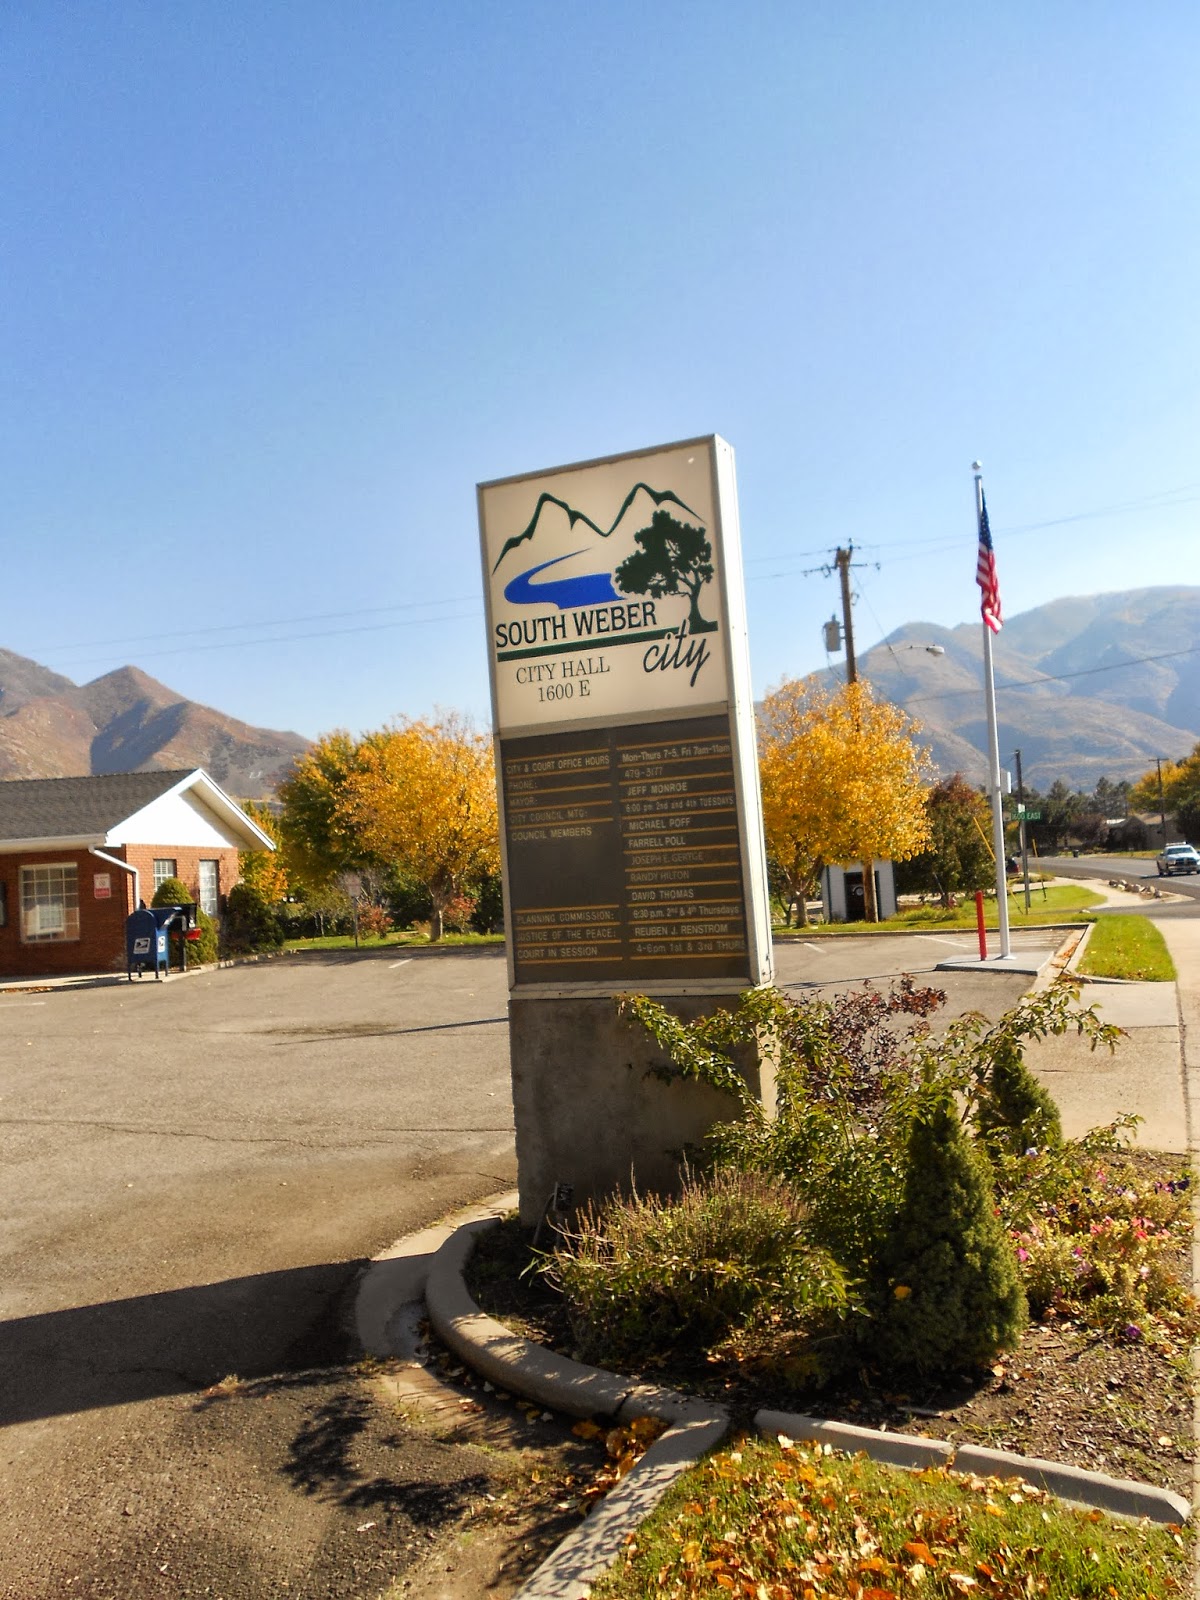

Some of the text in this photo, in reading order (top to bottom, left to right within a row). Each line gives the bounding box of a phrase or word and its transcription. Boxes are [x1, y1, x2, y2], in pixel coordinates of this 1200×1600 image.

[496, 601, 657, 648] SOUTH WEBER
[643, 619, 710, 687] city
[516, 656, 610, 684] CITY HALL
[538, 680, 591, 702] 1600 E
[622, 751, 661, 763] Mon-Thurs
[681, 747, 691, 756] Fri
[506, 764, 520, 774] CITY
[532, 761, 555, 772] COURT
[558, 758, 582, 769] OFFICE
[585, 755, 610, 766] HOURS
[627, 782, 688, 796] JEFF MONROE
[656, 801, 668, 810] 2nd
[686, 798, 697, 807] 4th
[700, 796, 735, 807] TUESDAYS
[530, 811, 564, 822] COUNCIL
[567, 808, 588, 818] MTG:
[1026, 812, 1040, 820] EAST
[629, 818, 691, 830] MICHAEL POFF
[511, 827, 592, 841] COUNCIL MEMBERS
[628, 836, 686, 848] FARRELL POLL
[631, 855, 660, 865] JOSEPH
[630, 870, 690, 882] RANDY HILTON
[631, 889, 695, 900] DAVID THOMAS
[517, 911, 614, 925] PLANNING COMMISSION:
[680, 907, 686, 916] &
[699, 905, 739, 917] Thursdays
[517, 931, 547, 941] JUSTICE
[552, 930, 562, 940] OF
[567, 929, 581, 939] THE
[635, 926, 668, 936] REUBEN
[681, 924, 728, 934] RENSTROM
[517, 946, 598, 959] COURT IN SESSION
